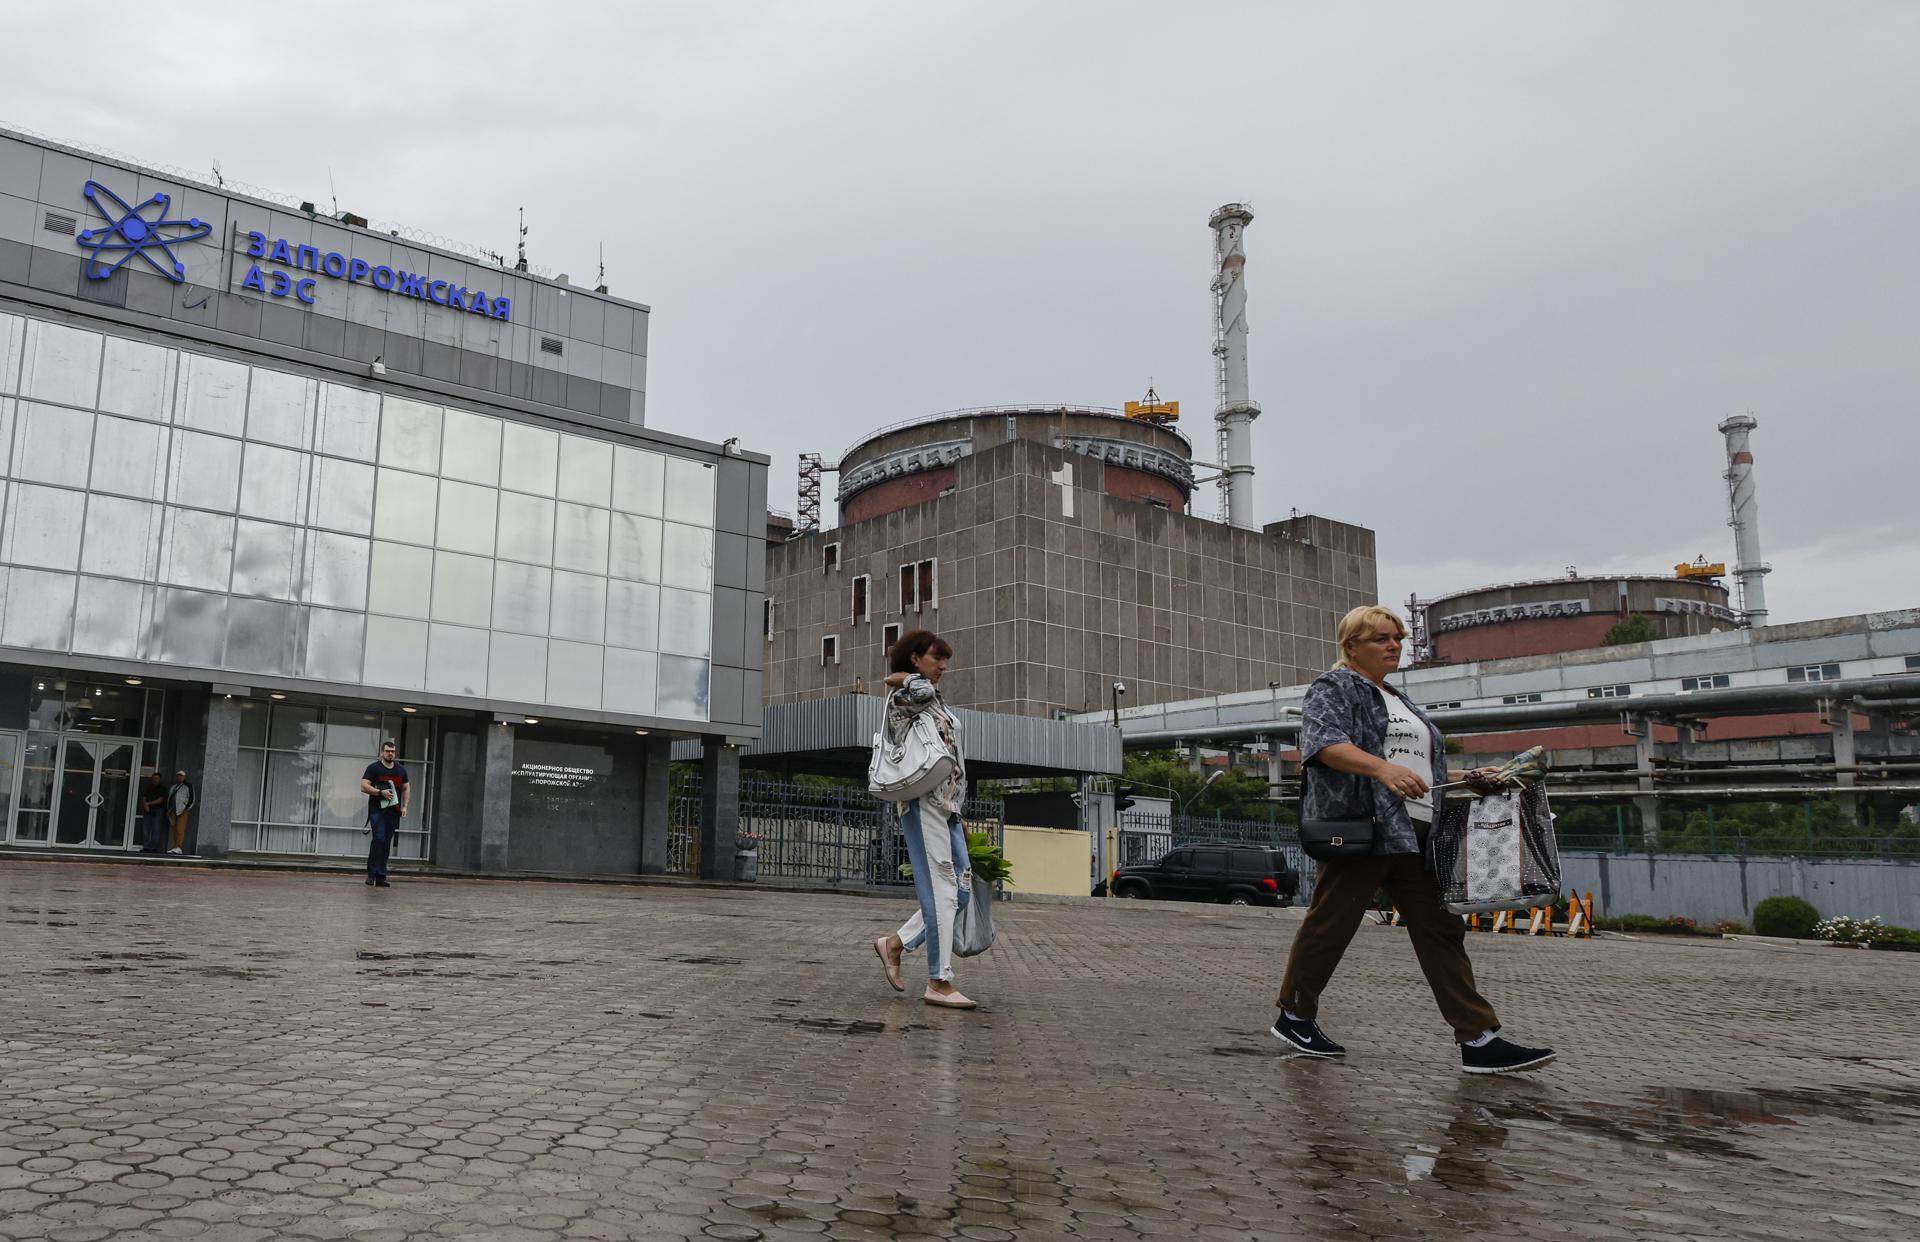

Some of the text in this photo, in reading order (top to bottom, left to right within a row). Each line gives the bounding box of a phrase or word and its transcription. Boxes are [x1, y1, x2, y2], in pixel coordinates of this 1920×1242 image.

[241, 264, 317, 305] АЭС
[247, 230, 511, 322] ЗАПОРОЖСКАЯ
[1388, 747, 1425, 759] you are
[521, 763, 594, 775] АКЦИОНЕРНОЕ ОБЩЕСТВО
